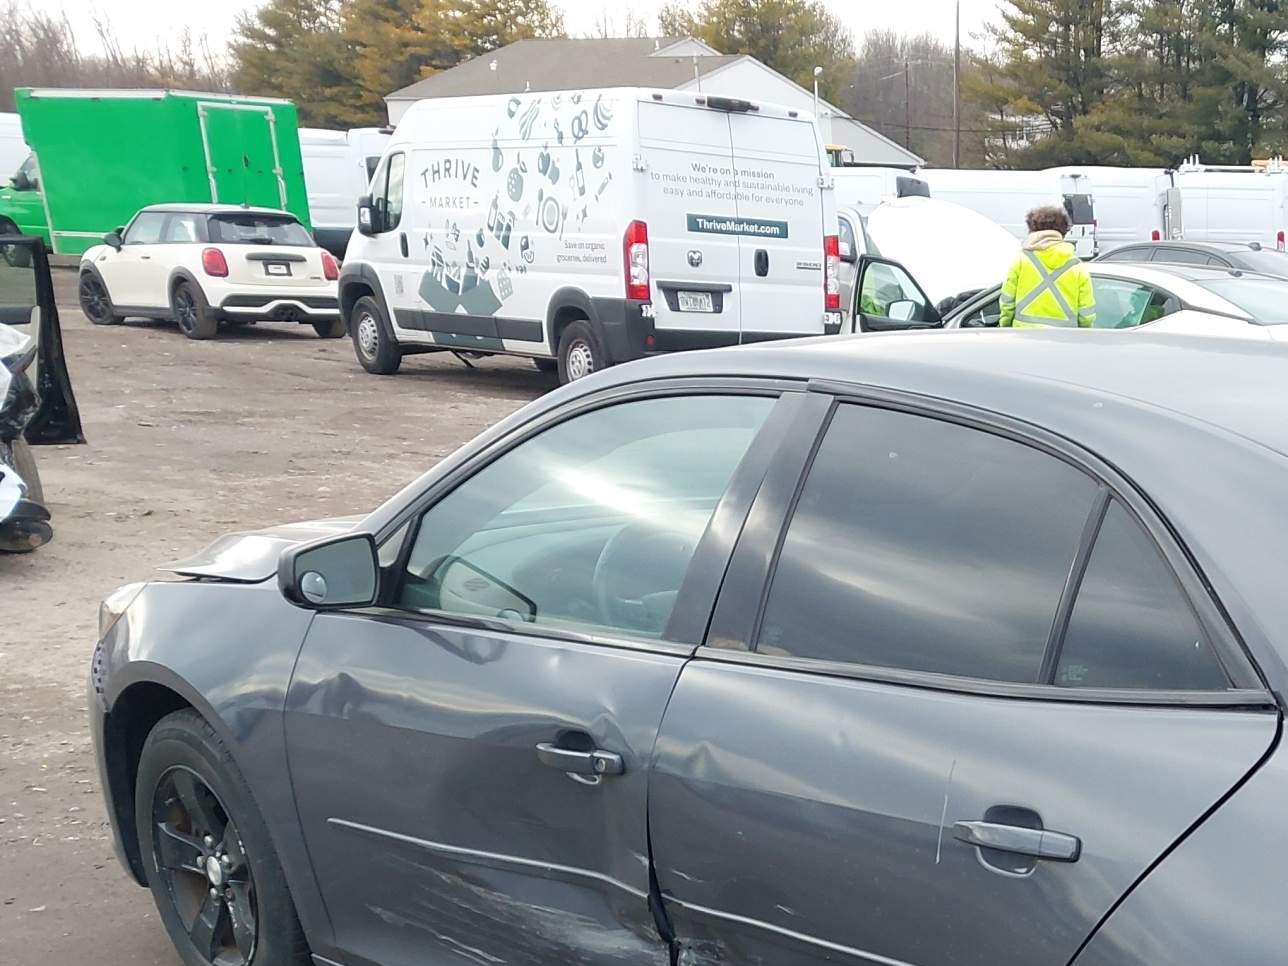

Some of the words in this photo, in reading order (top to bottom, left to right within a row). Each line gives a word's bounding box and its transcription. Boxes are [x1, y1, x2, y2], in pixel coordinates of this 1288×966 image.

[420, 158, 480, 189] THRIVE
[690, 162, 718, 175] We're
[719, 167, 732, 177] on
[740, 168, 775, 180] mission
[650, 170, 660, 181] to
[662, 173, 688, 184] make
[689, 175, 722, 189] healthy
[723, 178, 741, 188] and
[742, 180, 791, 194] sustainable
[791, 183, 815, 197] living
[429, 197, 471, 210] MARKET
[663, 186, 685, 198] easy
[686, 188, 703, 198] and
[704, 189, 750, 202] affordable
[751, 193, 763, 203] for
[765, 195, 805, 209] everyone
[695, 218, 780, 235] ThriveMarket.com
